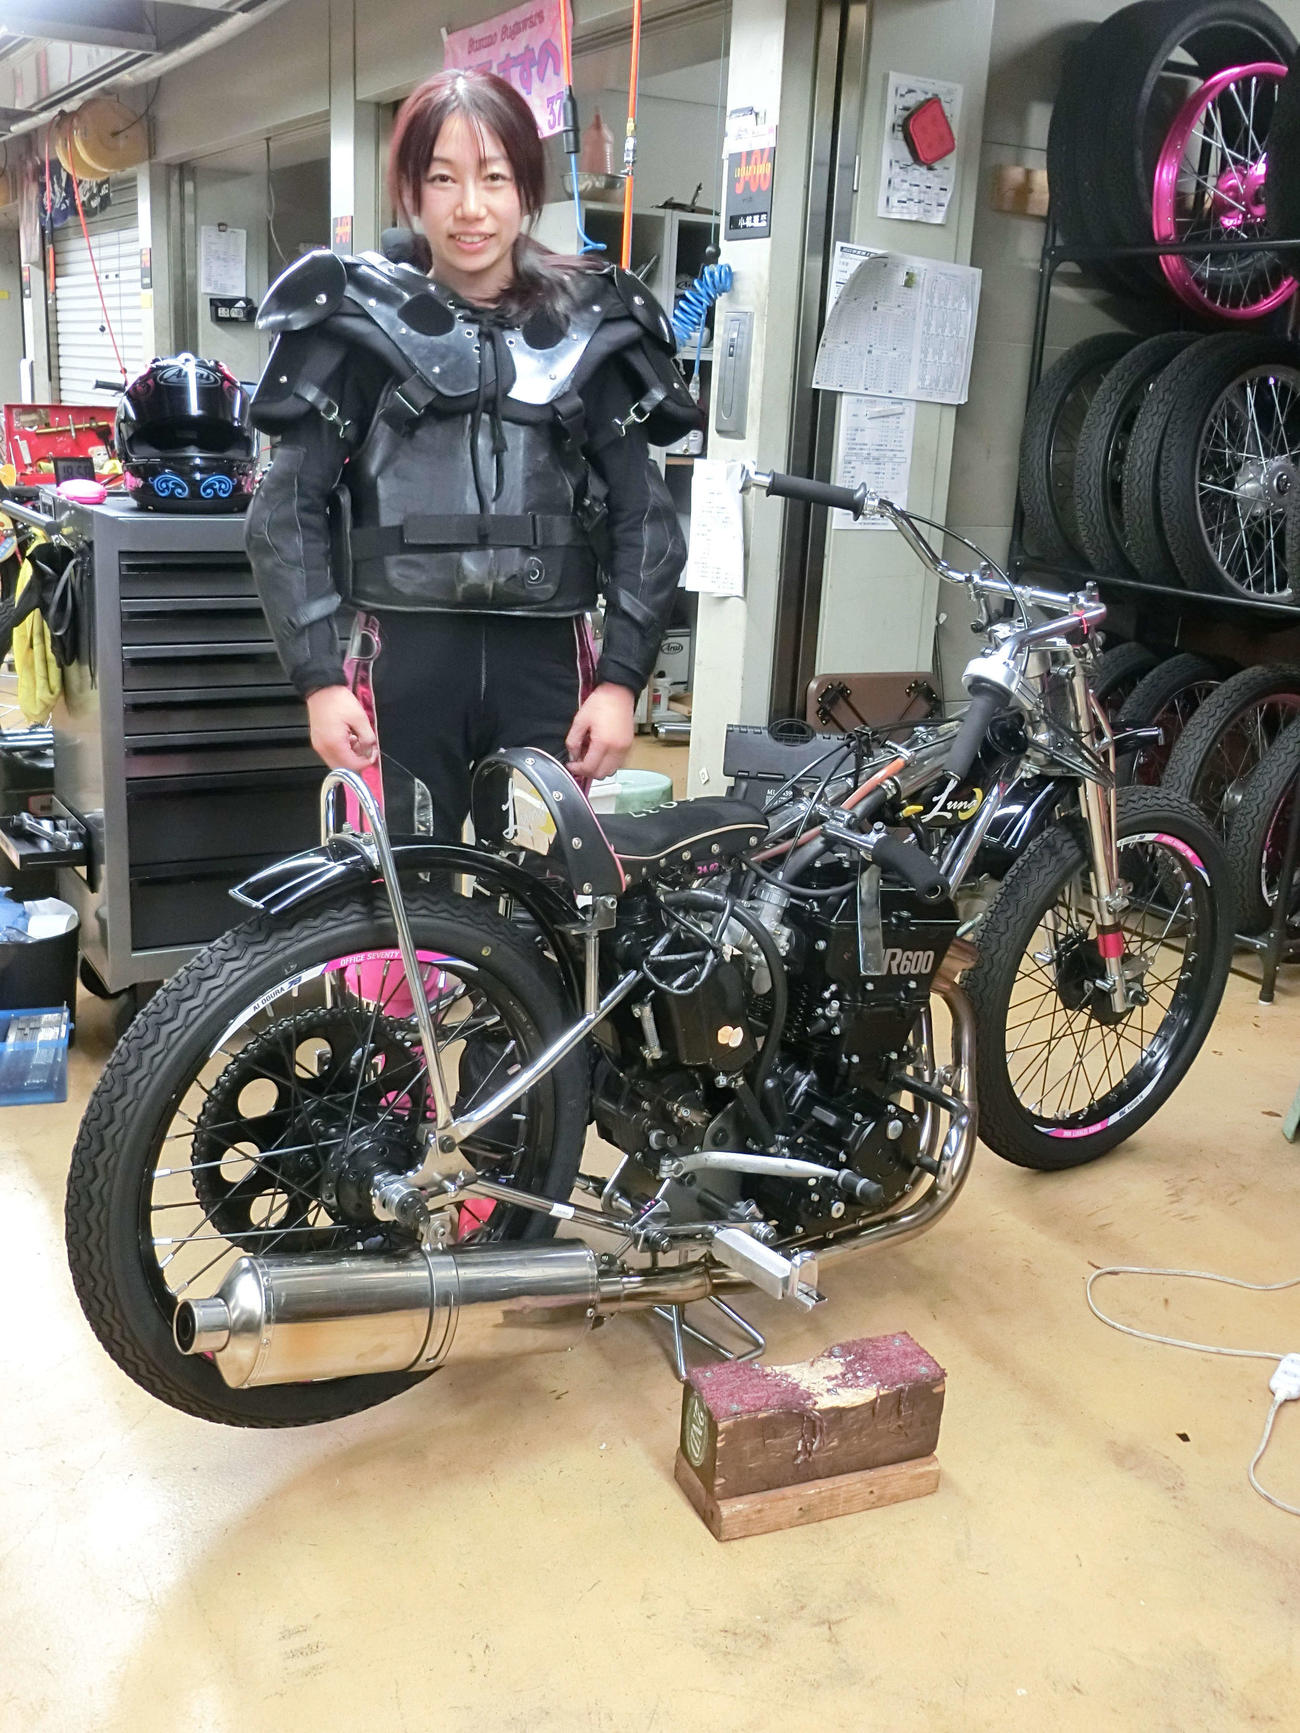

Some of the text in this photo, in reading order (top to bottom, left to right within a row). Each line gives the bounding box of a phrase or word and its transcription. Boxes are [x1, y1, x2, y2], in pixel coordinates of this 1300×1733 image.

[921, 778, 979, 823] Luna
[340, 951, 400, 967] OFFICE SEVENTY
[881, 948, 935, 976] R600
[252, 1003, 261, 1013] AI
